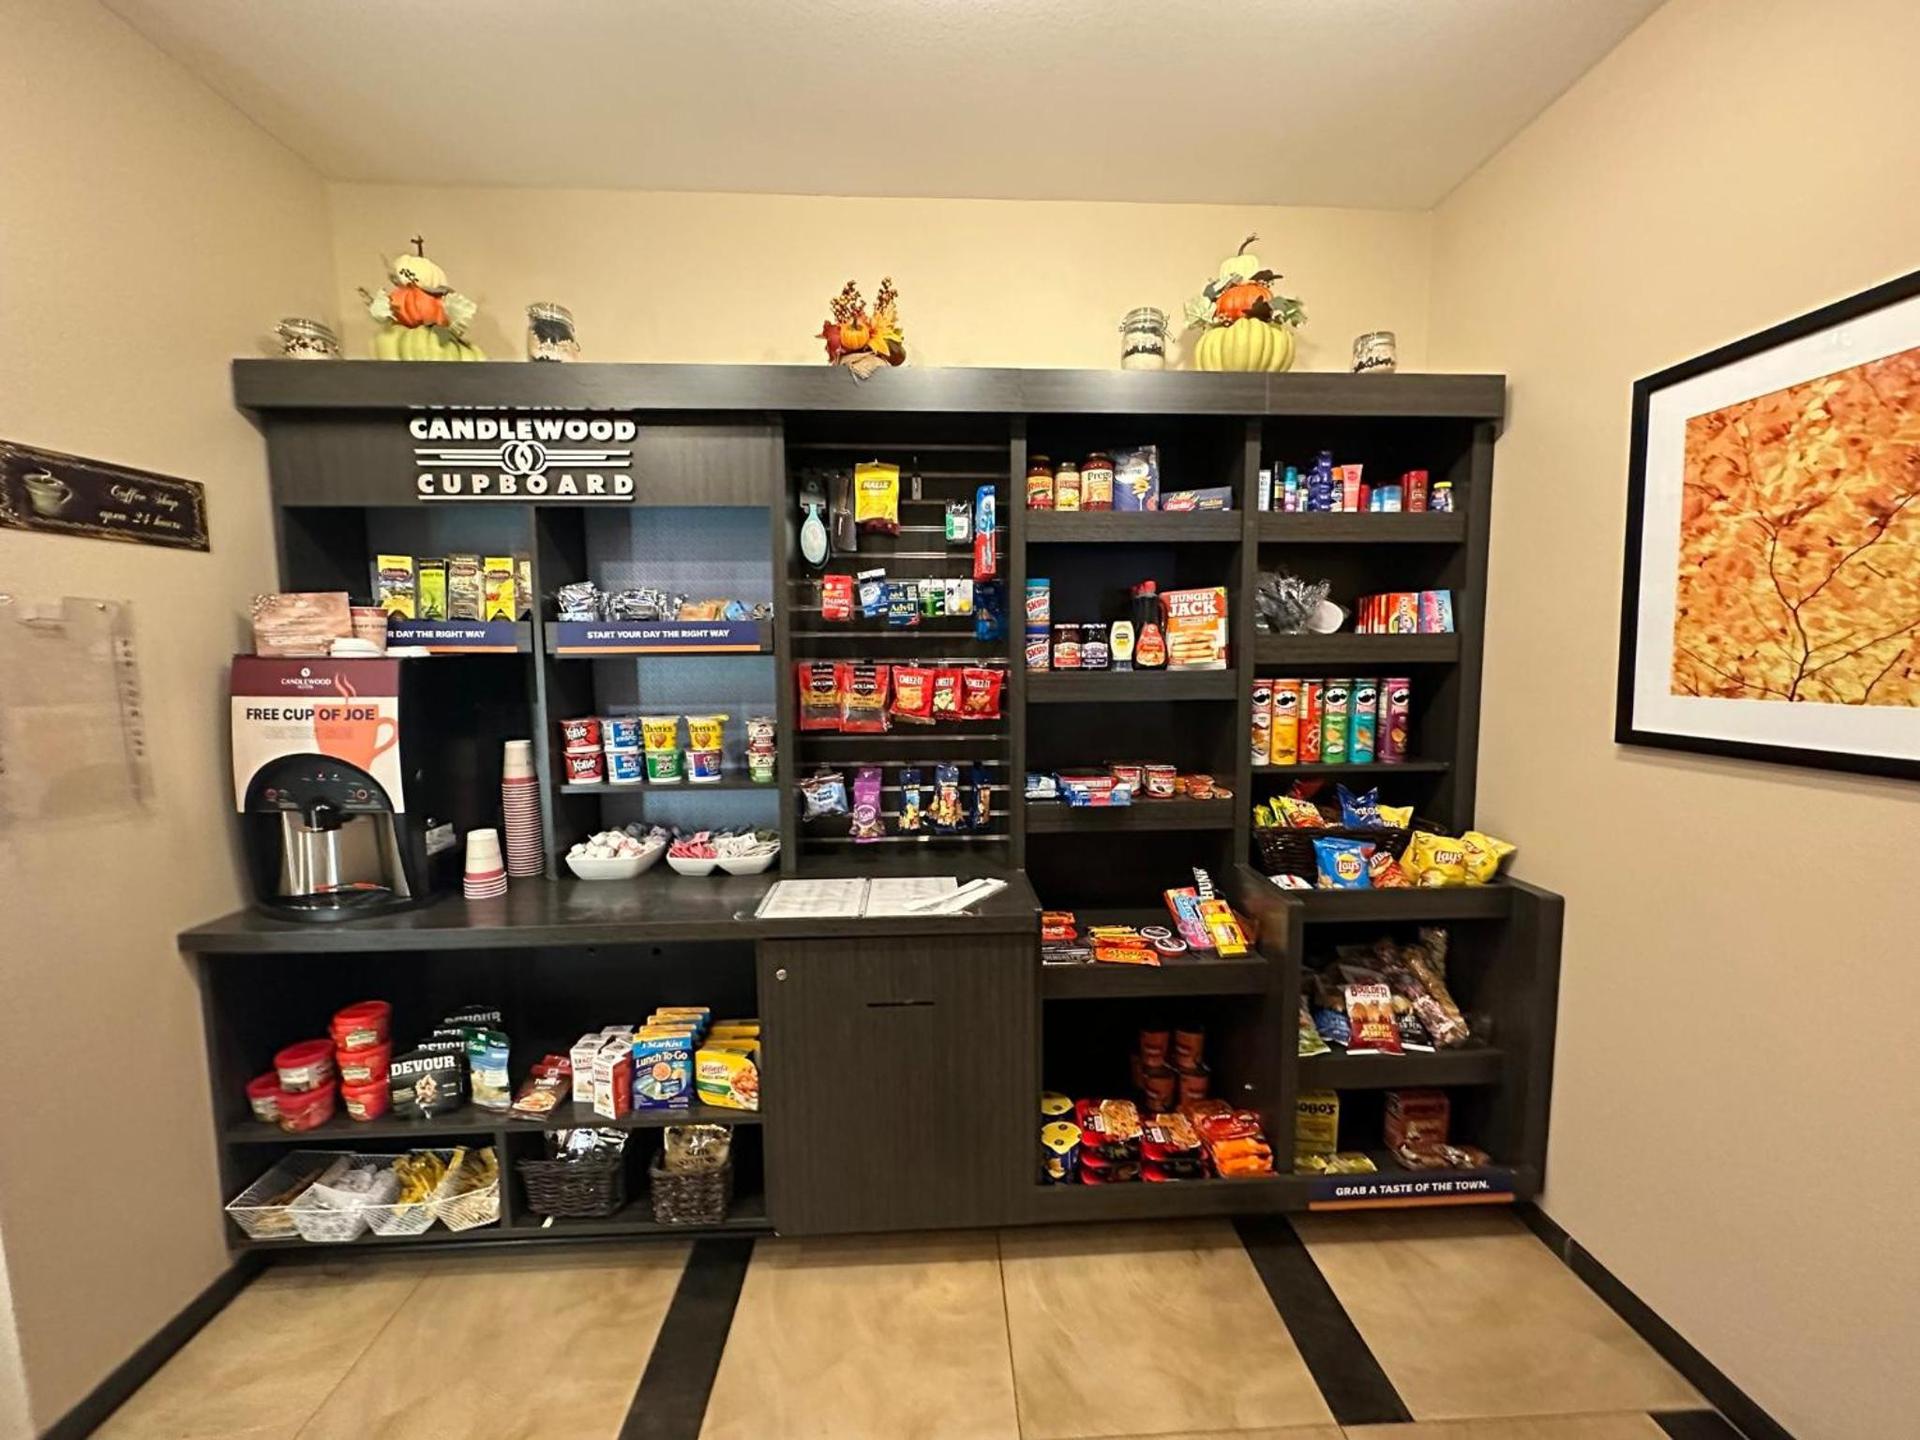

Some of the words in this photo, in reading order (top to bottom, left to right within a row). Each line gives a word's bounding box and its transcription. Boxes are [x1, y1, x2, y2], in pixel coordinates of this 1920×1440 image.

[409, 417, 636, 441] CANDLEWOOD
[1087, 471, 1111, 481] Prego
[417, 474, 634, 494] CUPBOARD
[110, 485, 147, 505] Coffee
[154, 492, 179, 512] Shop
[132, 511, 151, 525] 24
[1170, 591, 1215, 604] HUNGRY
[1168, 600, 1218, 617] JACK
[396, 630, 413, 638] DAY
[416, 630, 434, 638] THE
[435, 630, 464, 638] RIGHT
[465, 630, 485, 638] WAY
[587, 631, 615, 639] START
[618, 630, 641, 639] YOUR
[643, 630, 660, 638] DAY
[662, 629, 680, 638] THE
[681, 629, 708, 638] RIGHT
[709, 628, 730, 637] WAY
[246, 708, 279, 721] FREE
[283, 708, 315, 721] CUP
[319, 708, 341, 721] OF
[344, 708, 375, 721] JOE
[391, 1056, 456, 1077] DEVOUR
[636, 1053, 661, 1068] Lunch
[662, 1050, 688, 1061] To-Go
[1300, 1102, 1336, 1115] OBO'S
[1335, 1185, 1366, 1196] GRAB
[1368, 1185, 1377, 1194] A
[1380, 1183, 1412, 1194] TASTE
[1414, 1182, 1429, 1192] OF
[1431, 1182, 1452, 1191] THE
[1455, 1180, 1490, 1190] TOWN.
